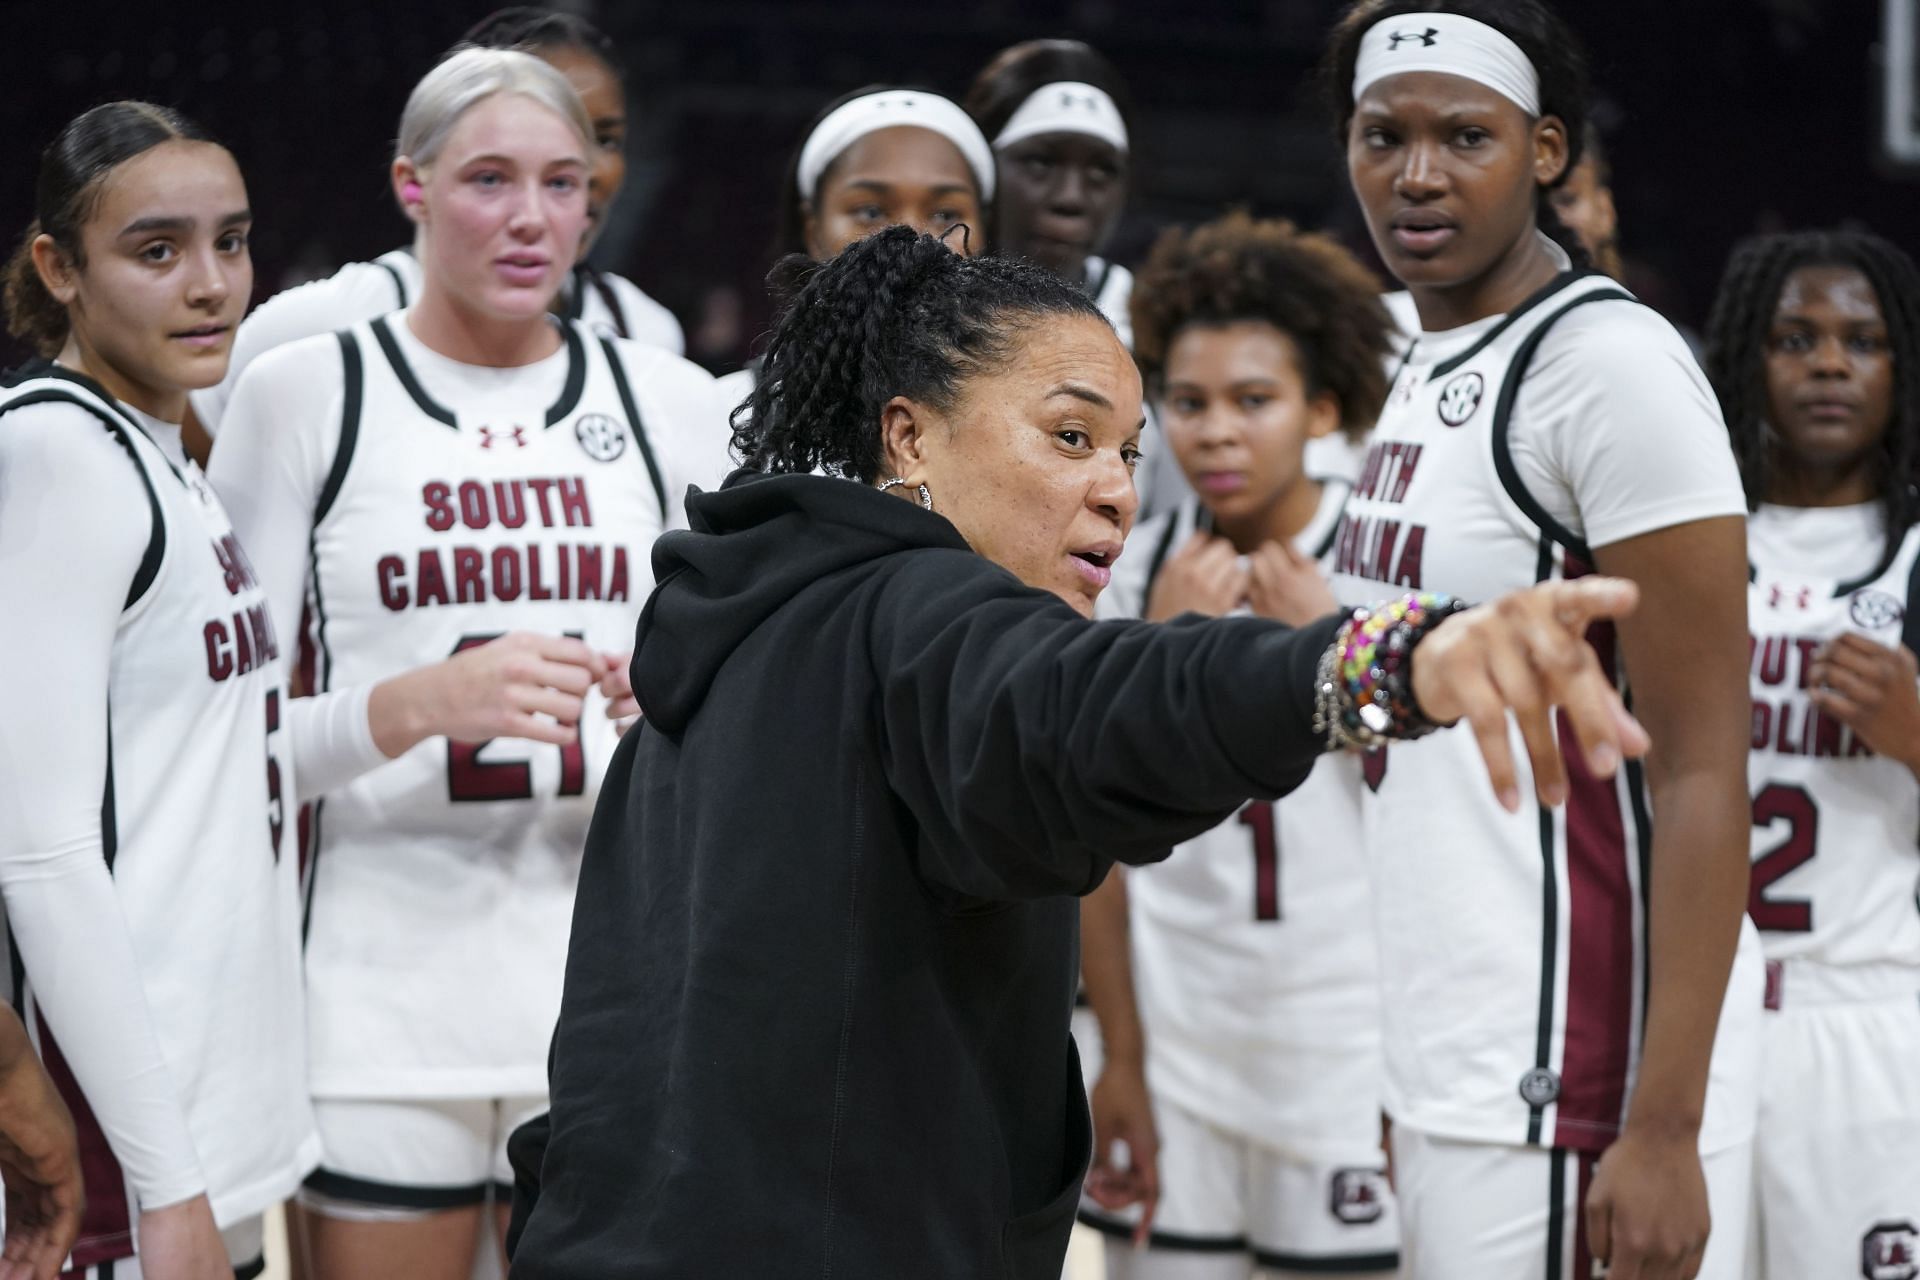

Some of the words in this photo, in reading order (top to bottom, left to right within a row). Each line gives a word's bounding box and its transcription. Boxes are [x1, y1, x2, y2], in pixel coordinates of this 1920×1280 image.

[422, 477, 593, 532] SOUTH
[377, 544, 630, 612] CAROLINA
[1239, 801, 1281, 921] 1
[1750, 782, 1819, 933] 2
